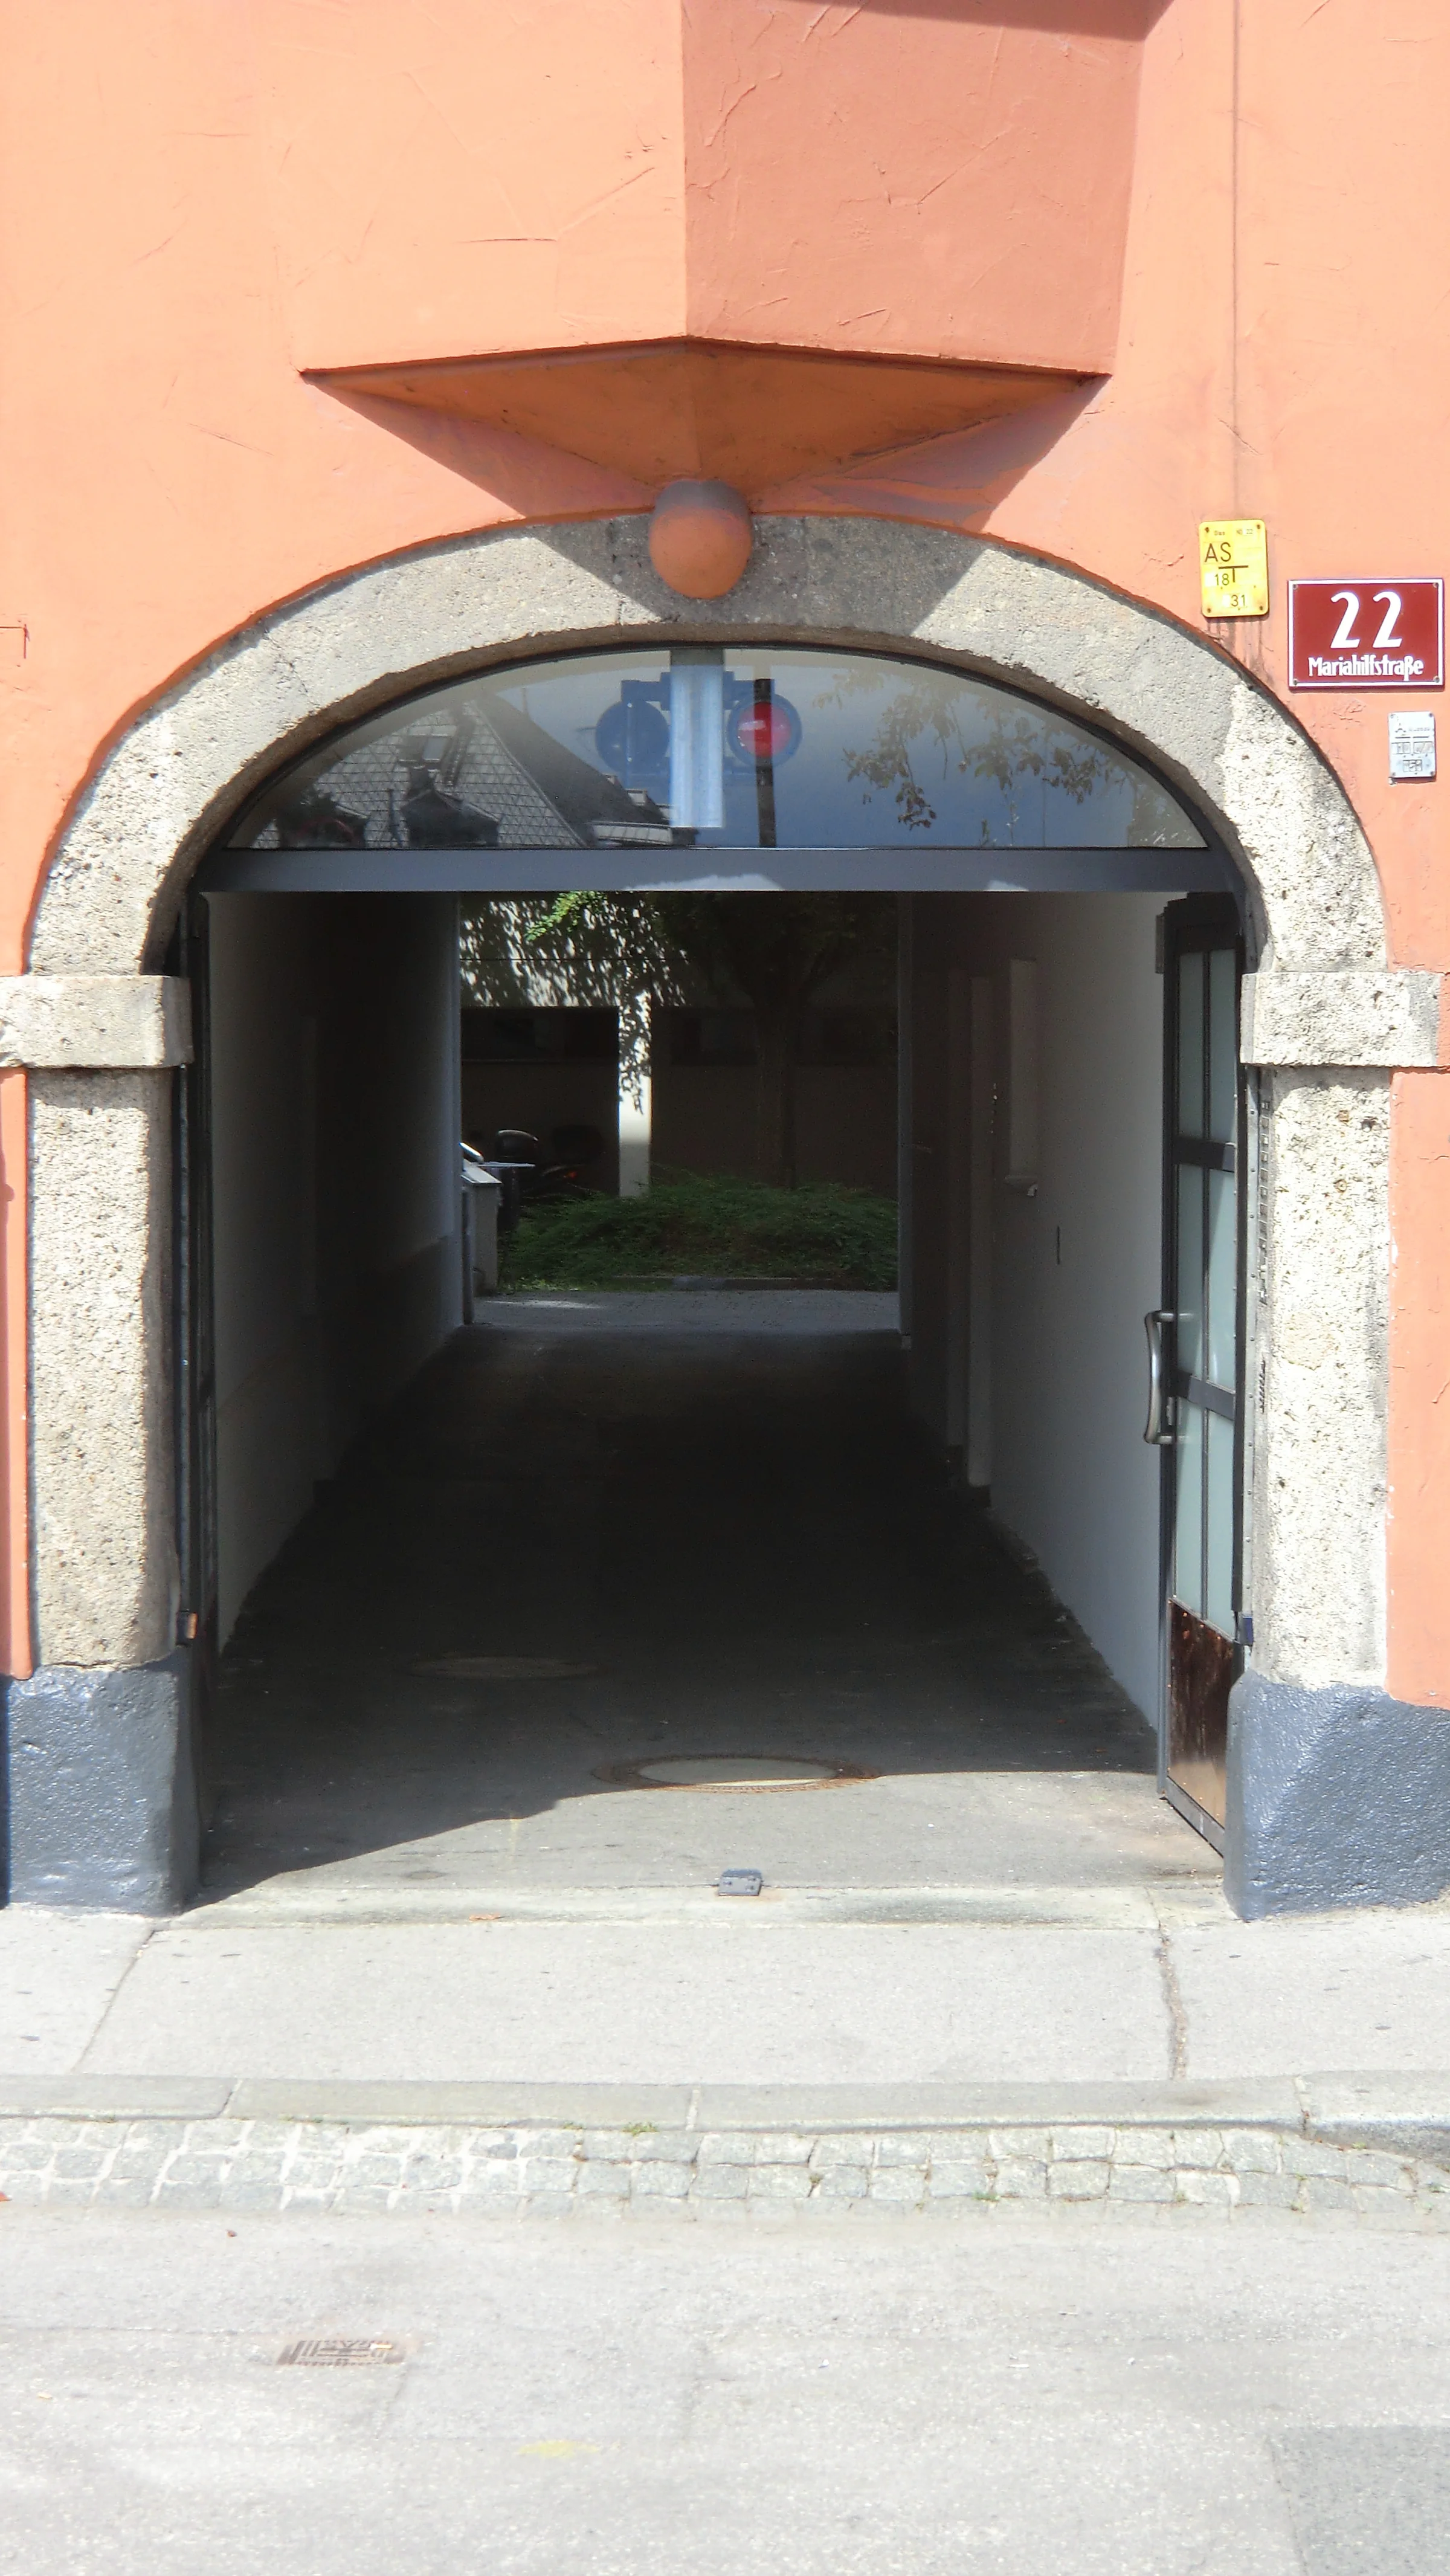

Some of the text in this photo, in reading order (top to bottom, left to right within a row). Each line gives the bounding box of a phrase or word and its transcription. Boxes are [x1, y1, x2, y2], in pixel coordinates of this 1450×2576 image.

[1205, 541, 1231, 563] AS
[1330, 591, 1402, 649] 22
[1308, 654, 1424, 682] Mariahilfstraße
